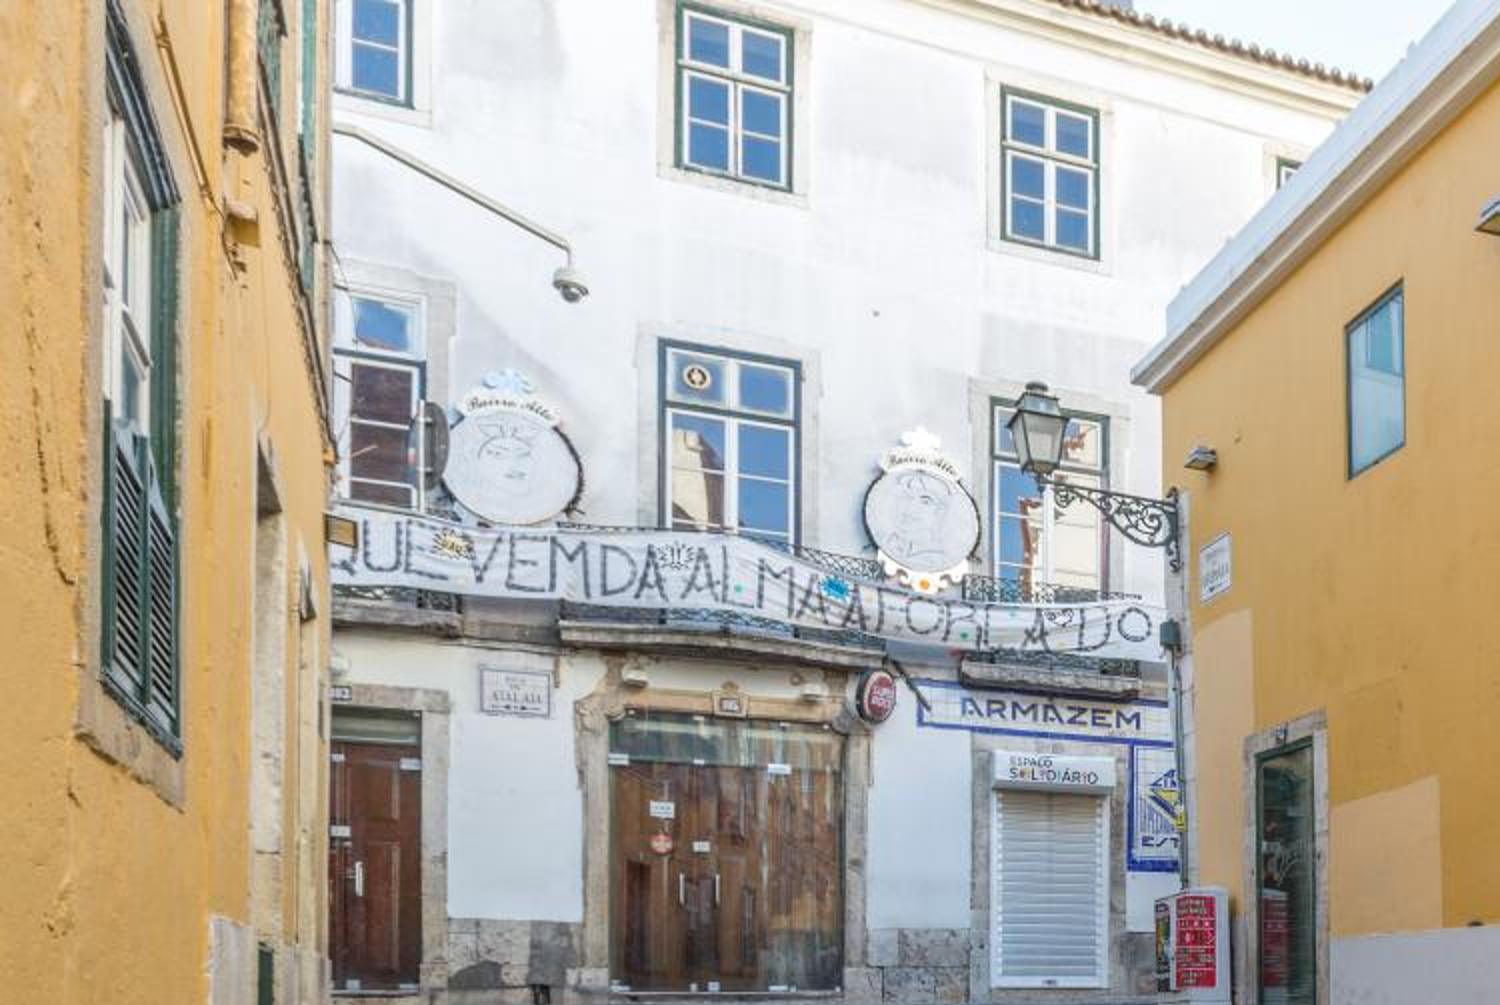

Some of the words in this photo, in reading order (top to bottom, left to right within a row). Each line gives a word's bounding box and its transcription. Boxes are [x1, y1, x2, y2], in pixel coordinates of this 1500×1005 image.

[465, 533, 591, 599] VEM
[600, 543, 669, 602] DA
[680, 545, 829, 625] ALMA
